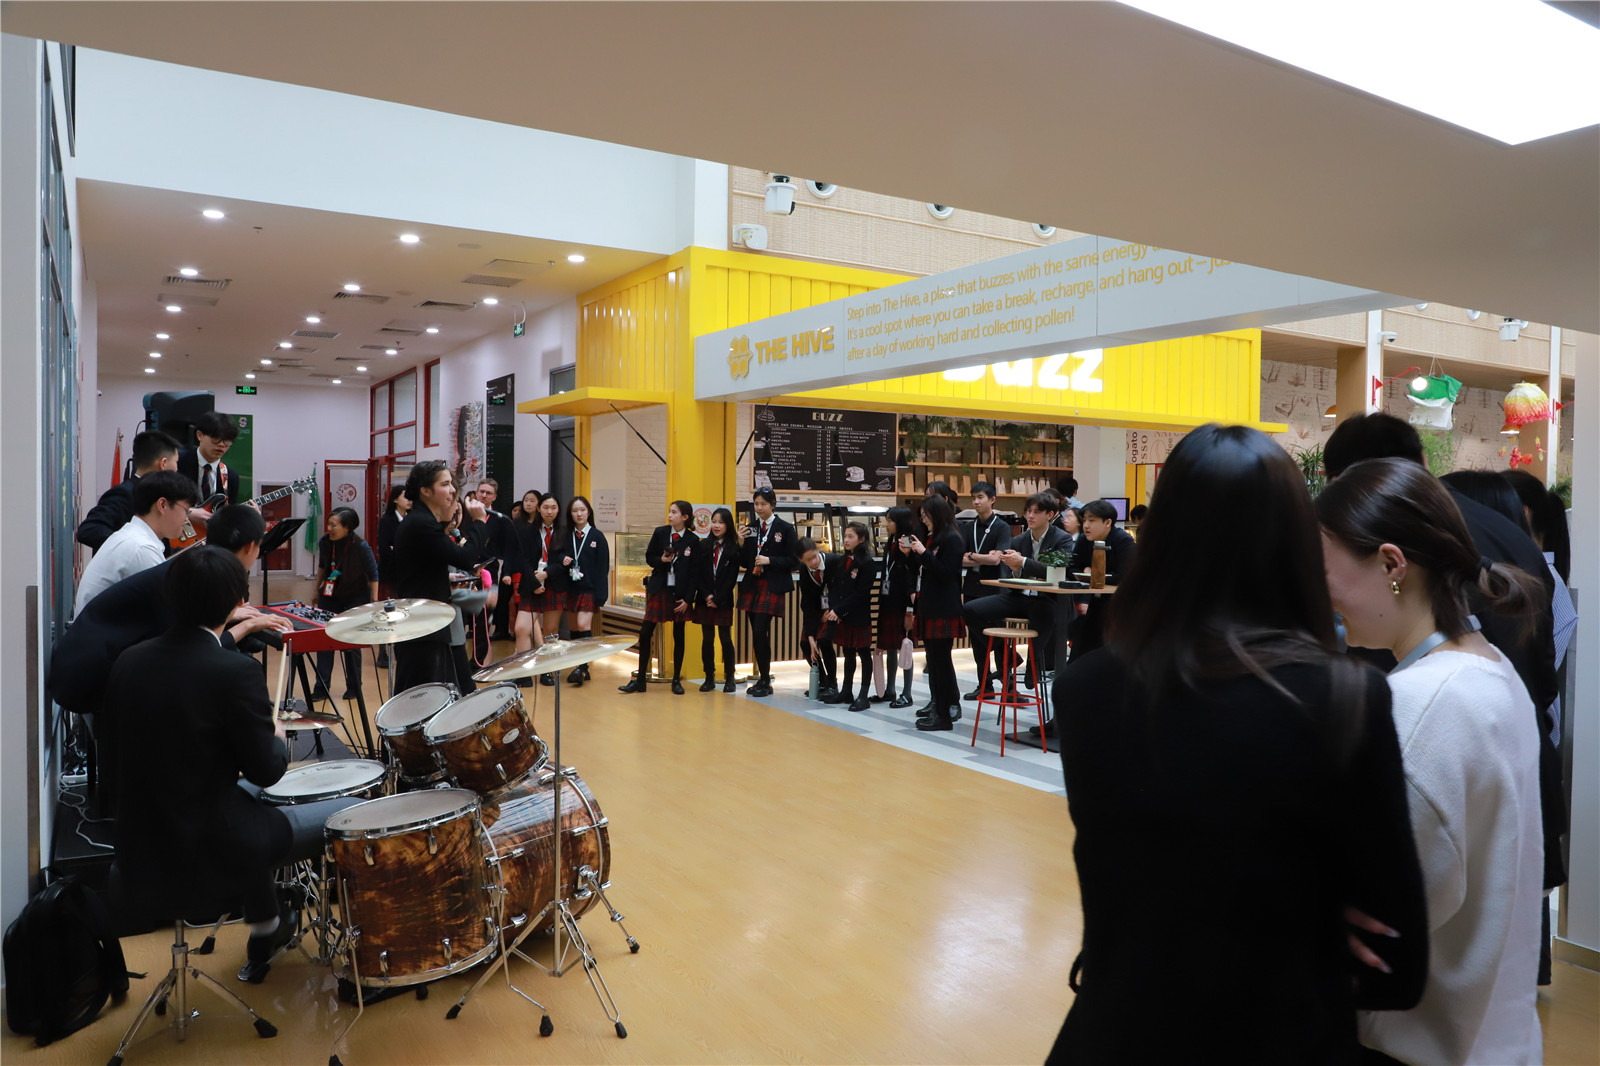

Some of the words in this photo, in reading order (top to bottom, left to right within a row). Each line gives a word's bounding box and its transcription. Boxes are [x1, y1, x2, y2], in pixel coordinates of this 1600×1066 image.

[847, 306, 865, 322] Step
[865, 303, 881, 317] into
[882, 297, 899, 312] The
[900, 293, 921, 308] Hive,
[923, 292, 929, 303] a
[930, 285, 956, 306] place
[957, 279, 976, 295] that
[979, 271, 1015, 291] buzzes
[1017, 262, 1041, 282] with
[1044, 258, 1063, 276] the
[1065, 251, 1099, 271] same
[1102, 243, 1148, 263] energy
[847, 328, 858, 341] It's
[858, 328, 864, 338] a
[865, 320, 883, 337] cool
[884, 317, 902, 336] spot
[904, 313, 932, 329] where
[933, 309, 951, 328] you
[953, 305, 970, 320] can
[972, 298, 994, 315] take
[995, 298, 1003, 310] a
[1005, 287, 1039, 309] break,
[1041, 279, 1096, 302] recharge,
[1099, 268, 1125, 291] and
[1128, 263, 1164, 284] hang
[1167, 255, 1194, 277] out
[755, 336, 788, 364] THE
[791, 325, 835, 357] HIVE
[847, 345, 865, 361] after
[866, 347, 871, 358] a
[872, 341, 888, 359] day
[889, 337, 899, 353] of
[899, 334, 935, 351] working
[937, 326, 959, 345] hard
[960, 322, 980, 341] and
[982, 315, 1032, 337] collecting
[1035, 305, 1075, 333] pollen!
[812, 411, 844, 423] BUZZ
[1131, 431, 1139, 463] ogato
